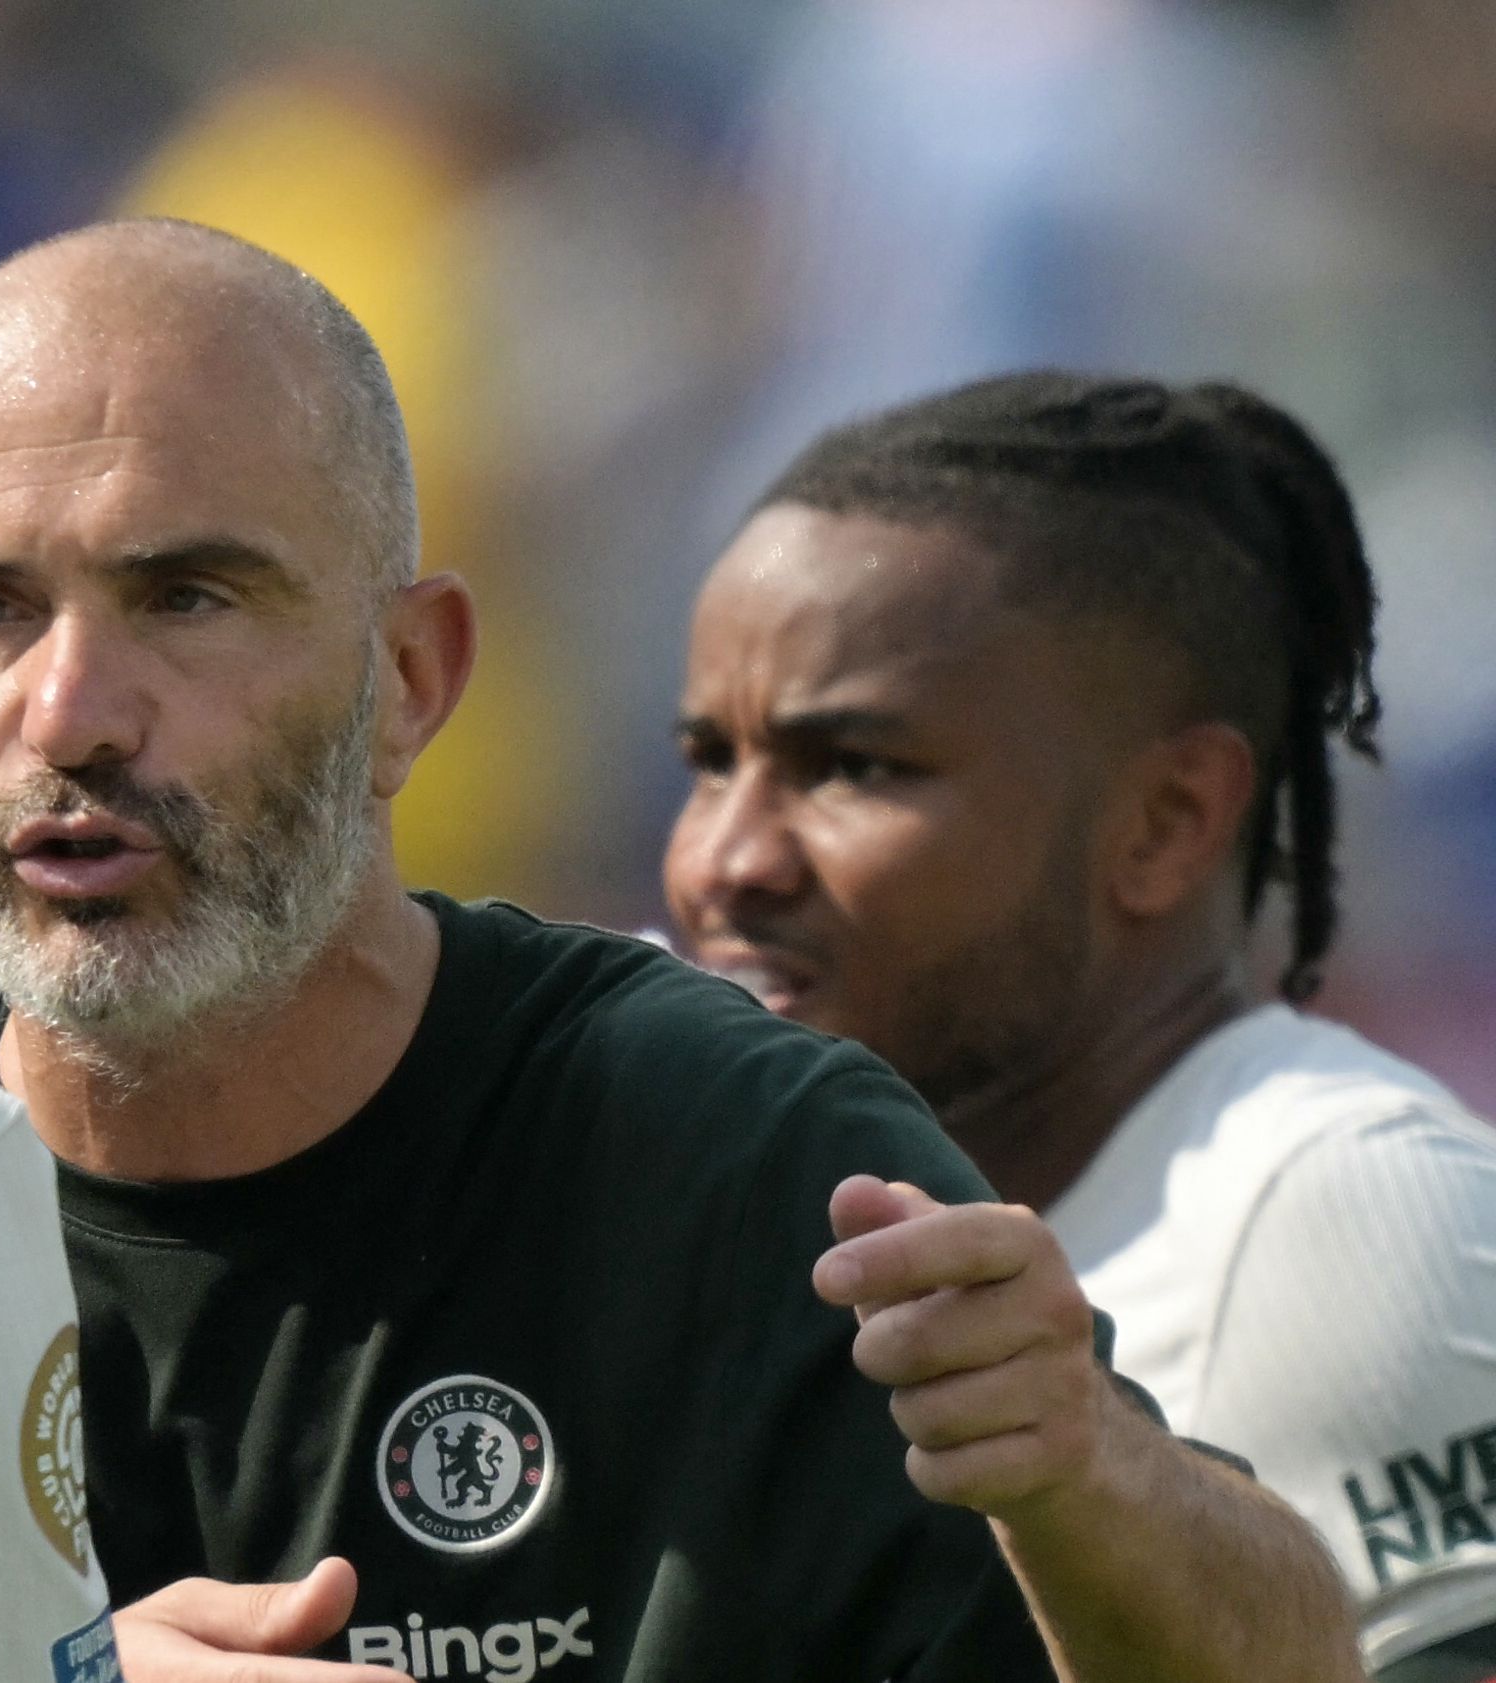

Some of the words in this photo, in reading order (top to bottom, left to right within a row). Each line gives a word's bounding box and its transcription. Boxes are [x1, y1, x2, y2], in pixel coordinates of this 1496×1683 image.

[410, 1391, 513, 1428] CHELSEA
[415, 1512, 486, 1539] FOOTBALL
[491, 1503, 525, 1531] CLUB
